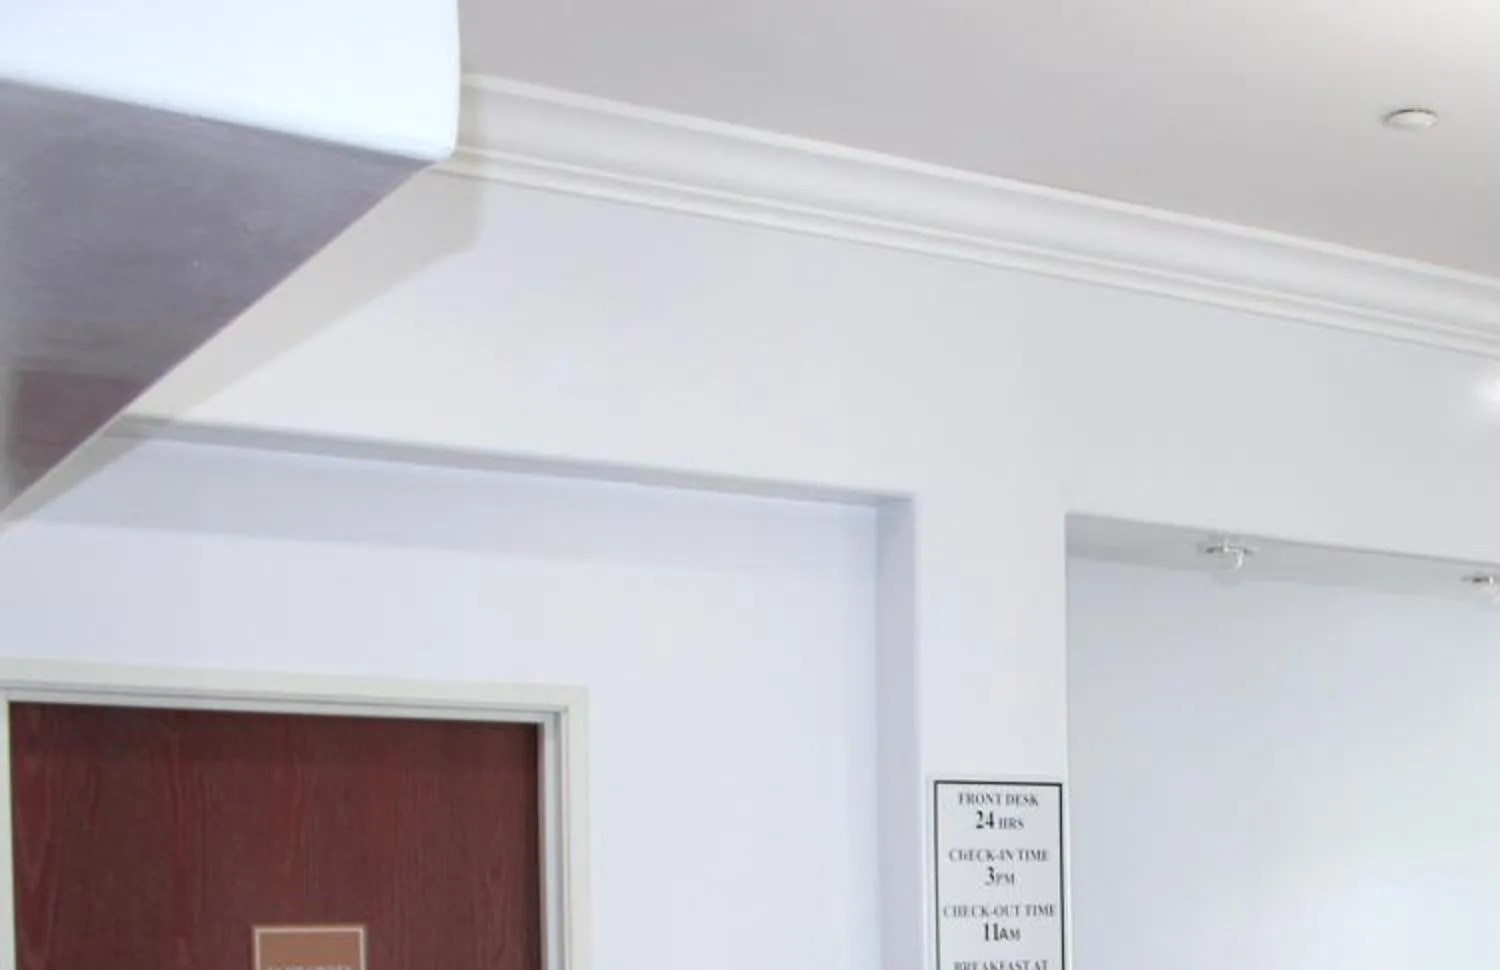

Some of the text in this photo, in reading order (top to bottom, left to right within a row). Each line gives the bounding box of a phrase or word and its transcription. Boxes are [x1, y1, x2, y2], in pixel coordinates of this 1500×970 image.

[957, 792, 1040, 807] FRONT DESK
[975, 809, 1025, 830] 24 HRS
[1017, 848, 1049, 863] TIME
[1024, 903, 1056, 918] TIME
